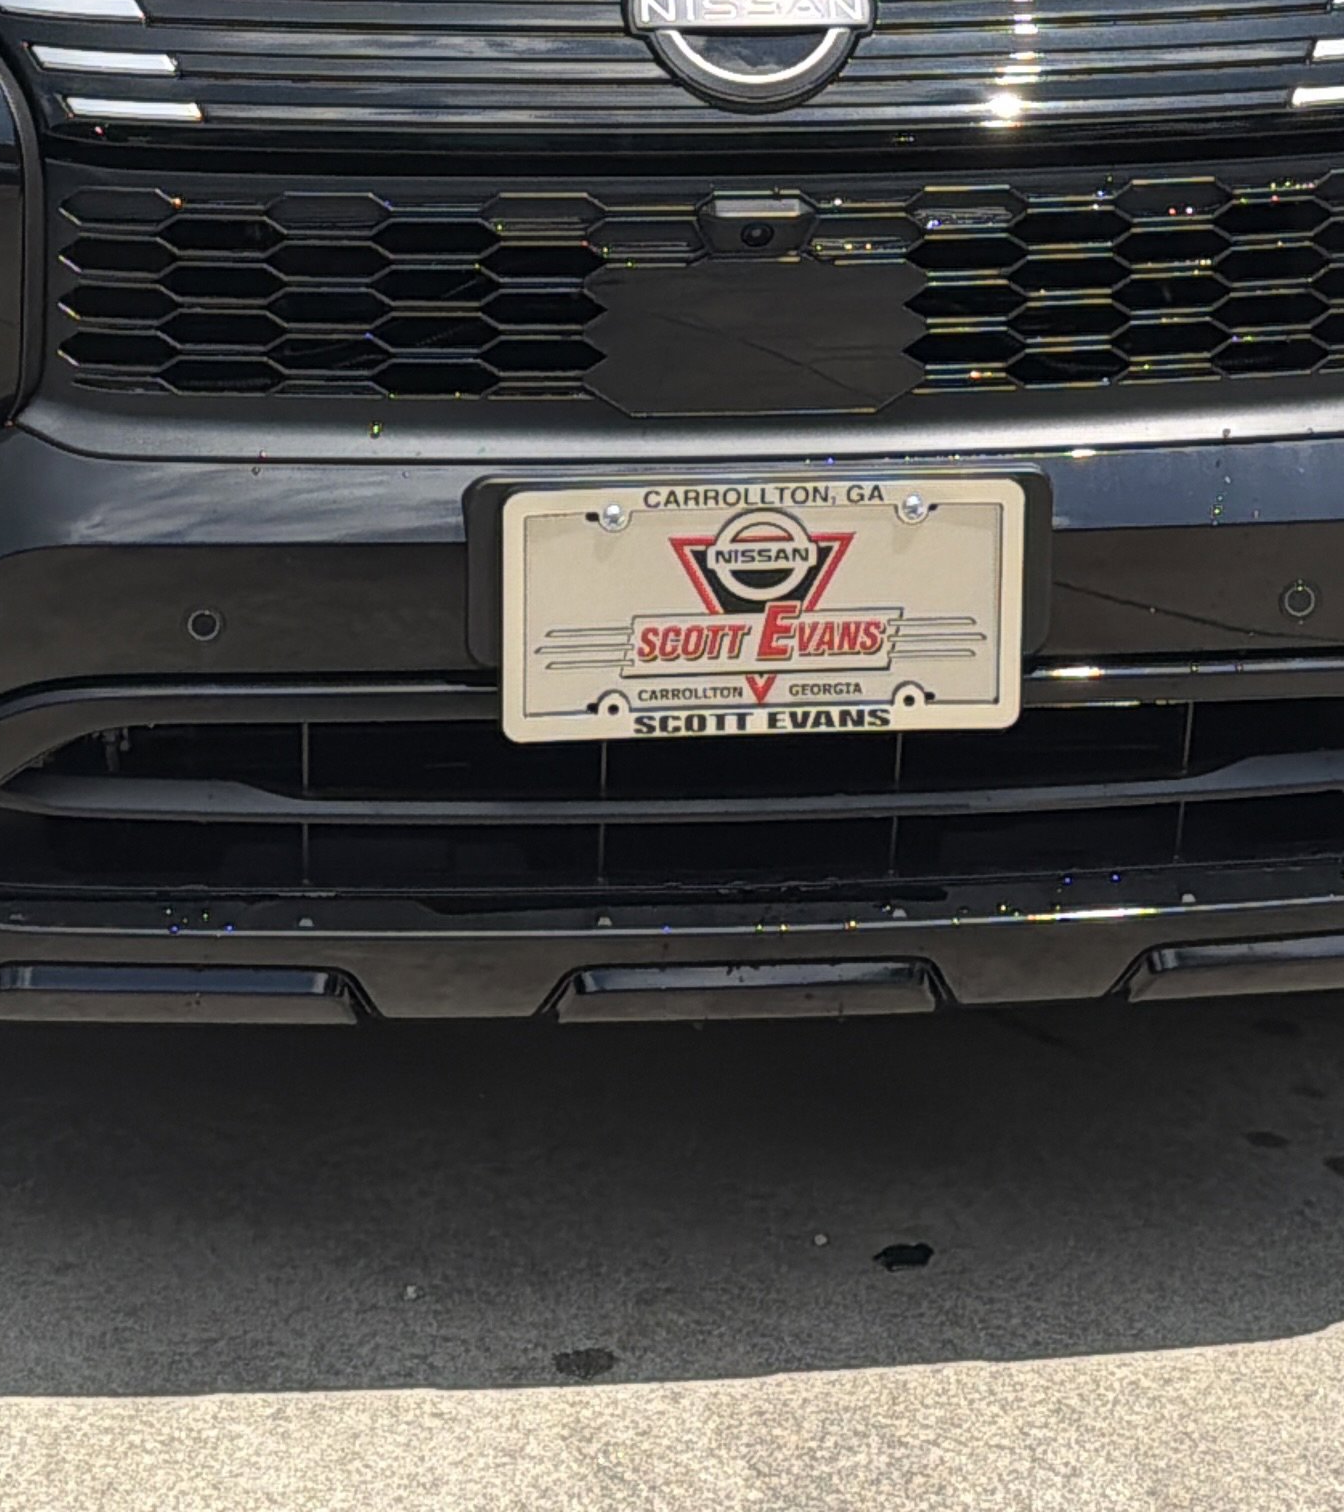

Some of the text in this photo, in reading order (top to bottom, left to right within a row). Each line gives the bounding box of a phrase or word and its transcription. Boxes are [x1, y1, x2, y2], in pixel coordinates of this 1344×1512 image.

[642, 483, 885, 509] CARROLLTON, GA
[714, 546, 809, 564] NISSAN
[636, 601, 886, 663] SCOTT EVANS
[637, 681, 863, 702] CARROLLTON GEORGIA
[633, 707, 891, 735] SCOTT EVANS
